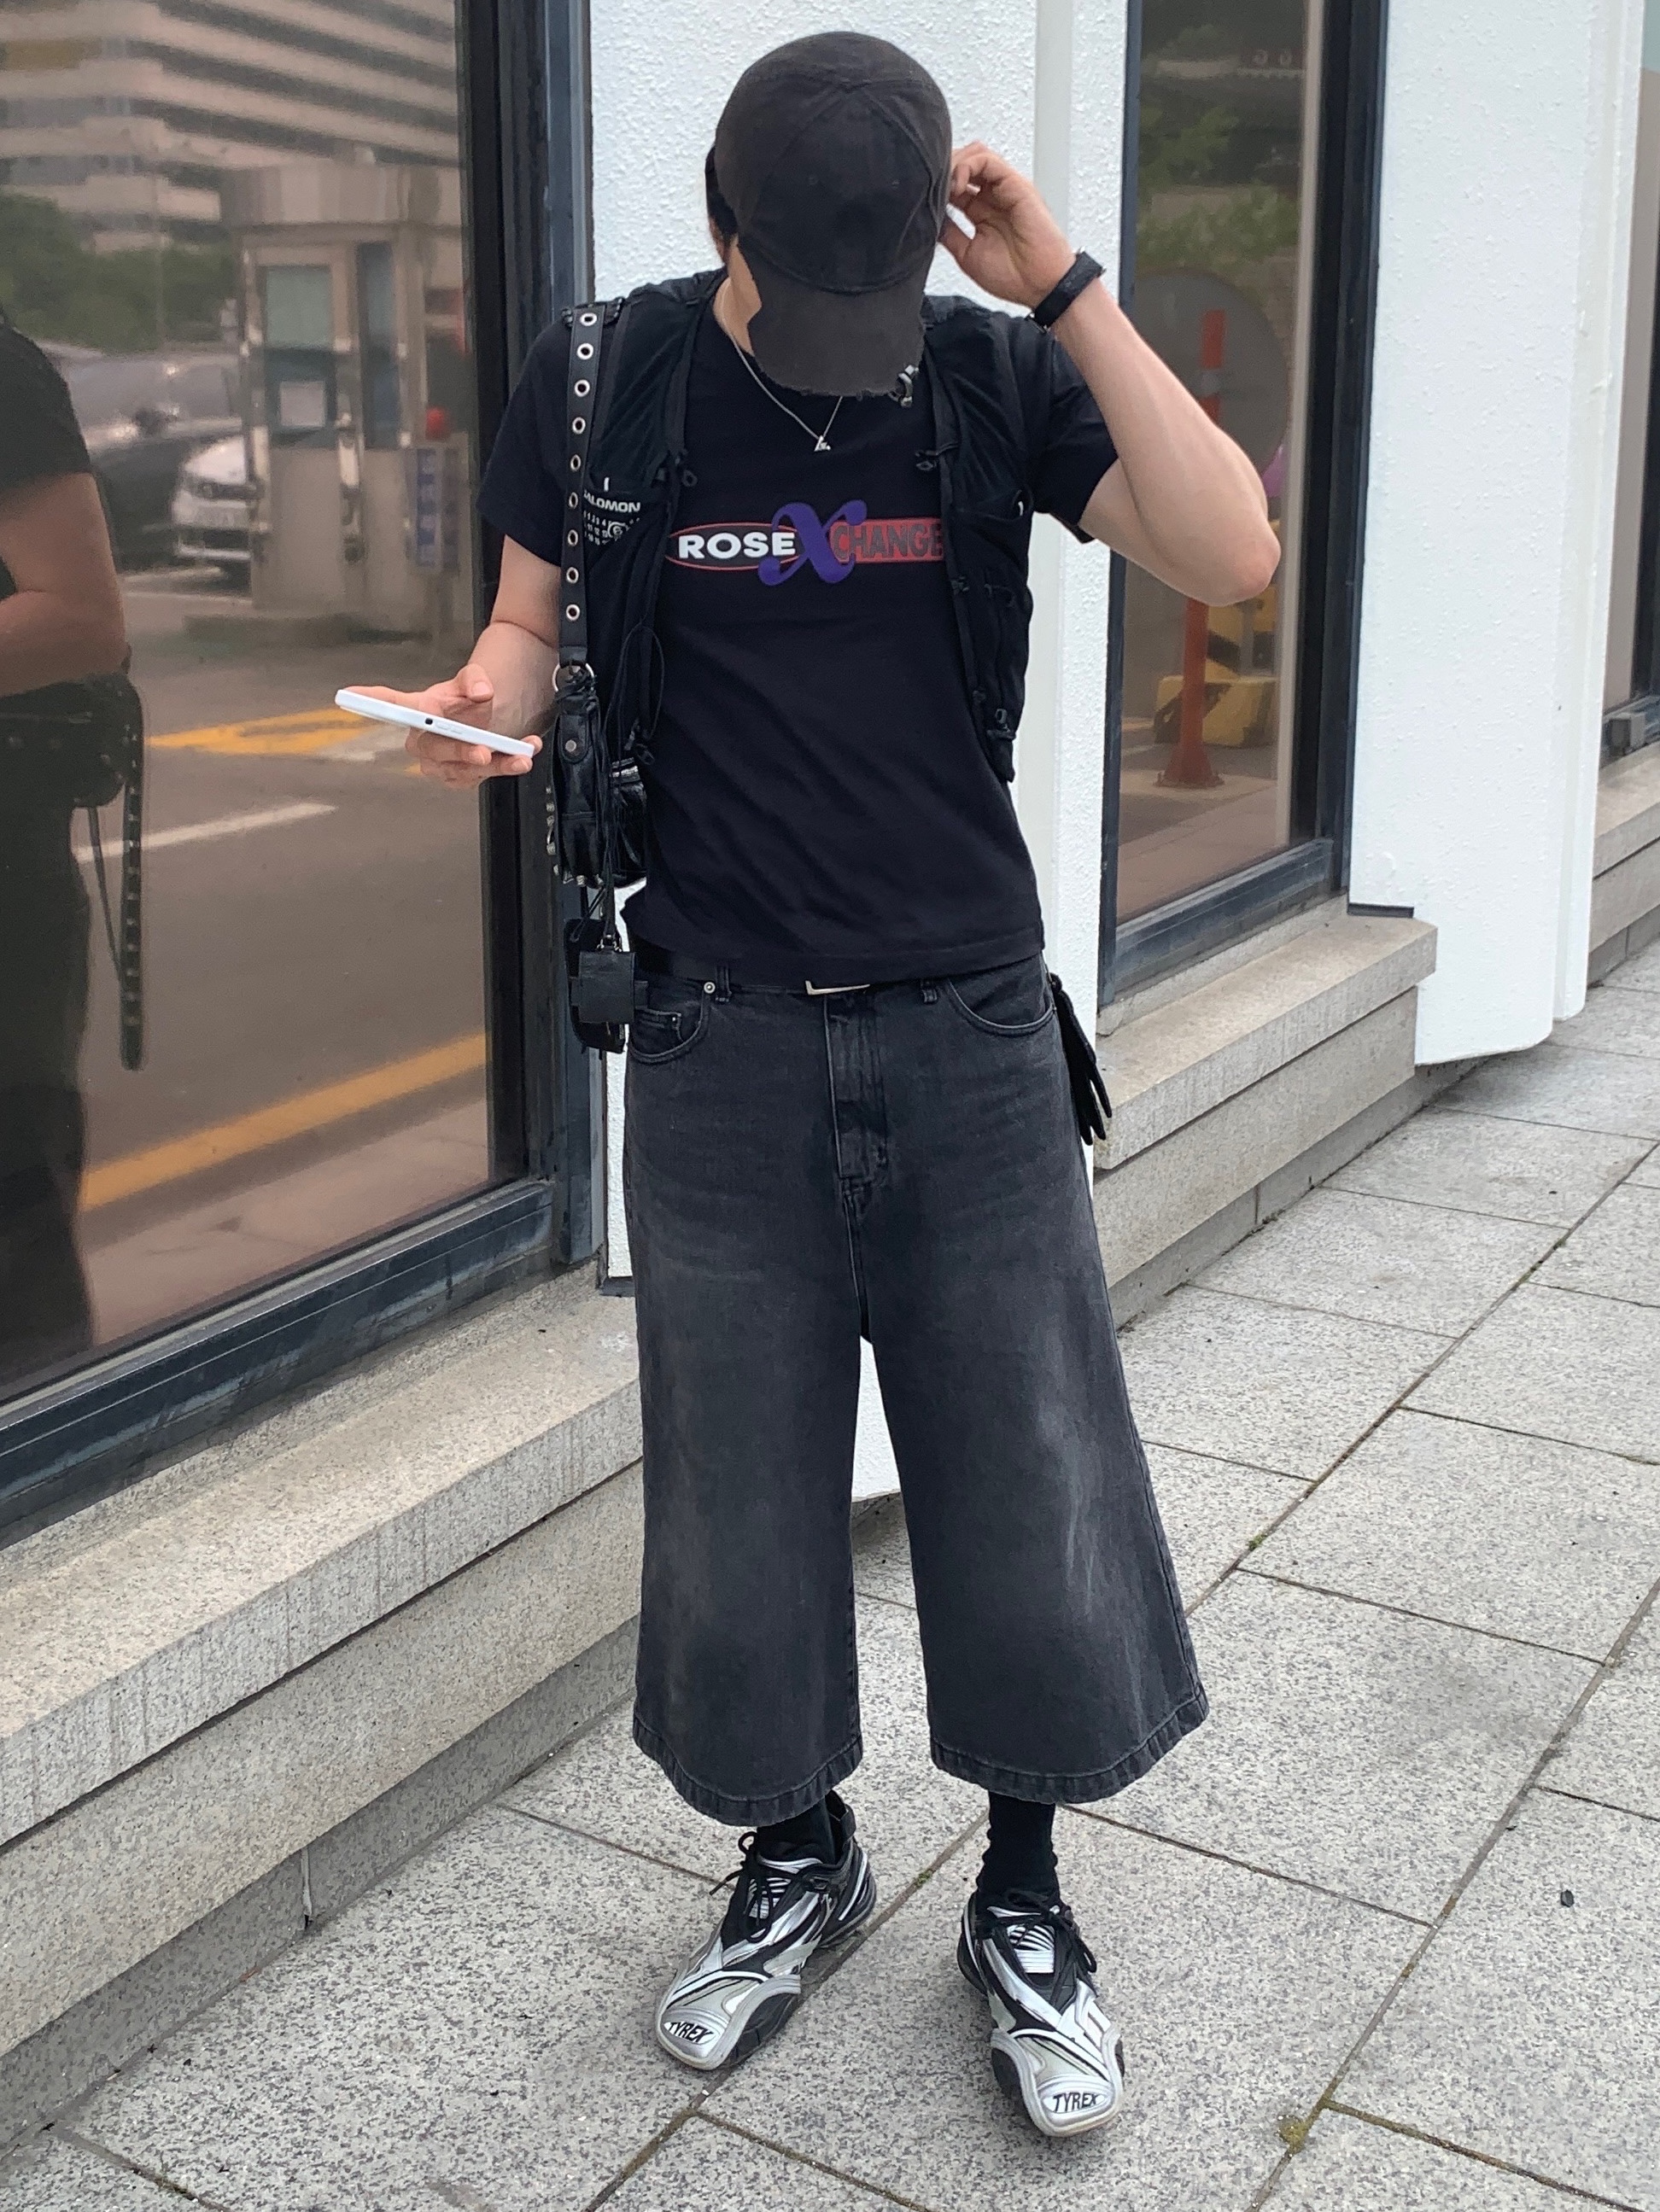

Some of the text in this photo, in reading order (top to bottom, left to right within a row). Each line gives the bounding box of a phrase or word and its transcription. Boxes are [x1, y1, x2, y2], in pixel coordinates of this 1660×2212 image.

[678, 531, 797, 559] ROSE
[669, 2021, 714, 2042] TYREX
[1053, 2092, 1099, 2112] TYREX
